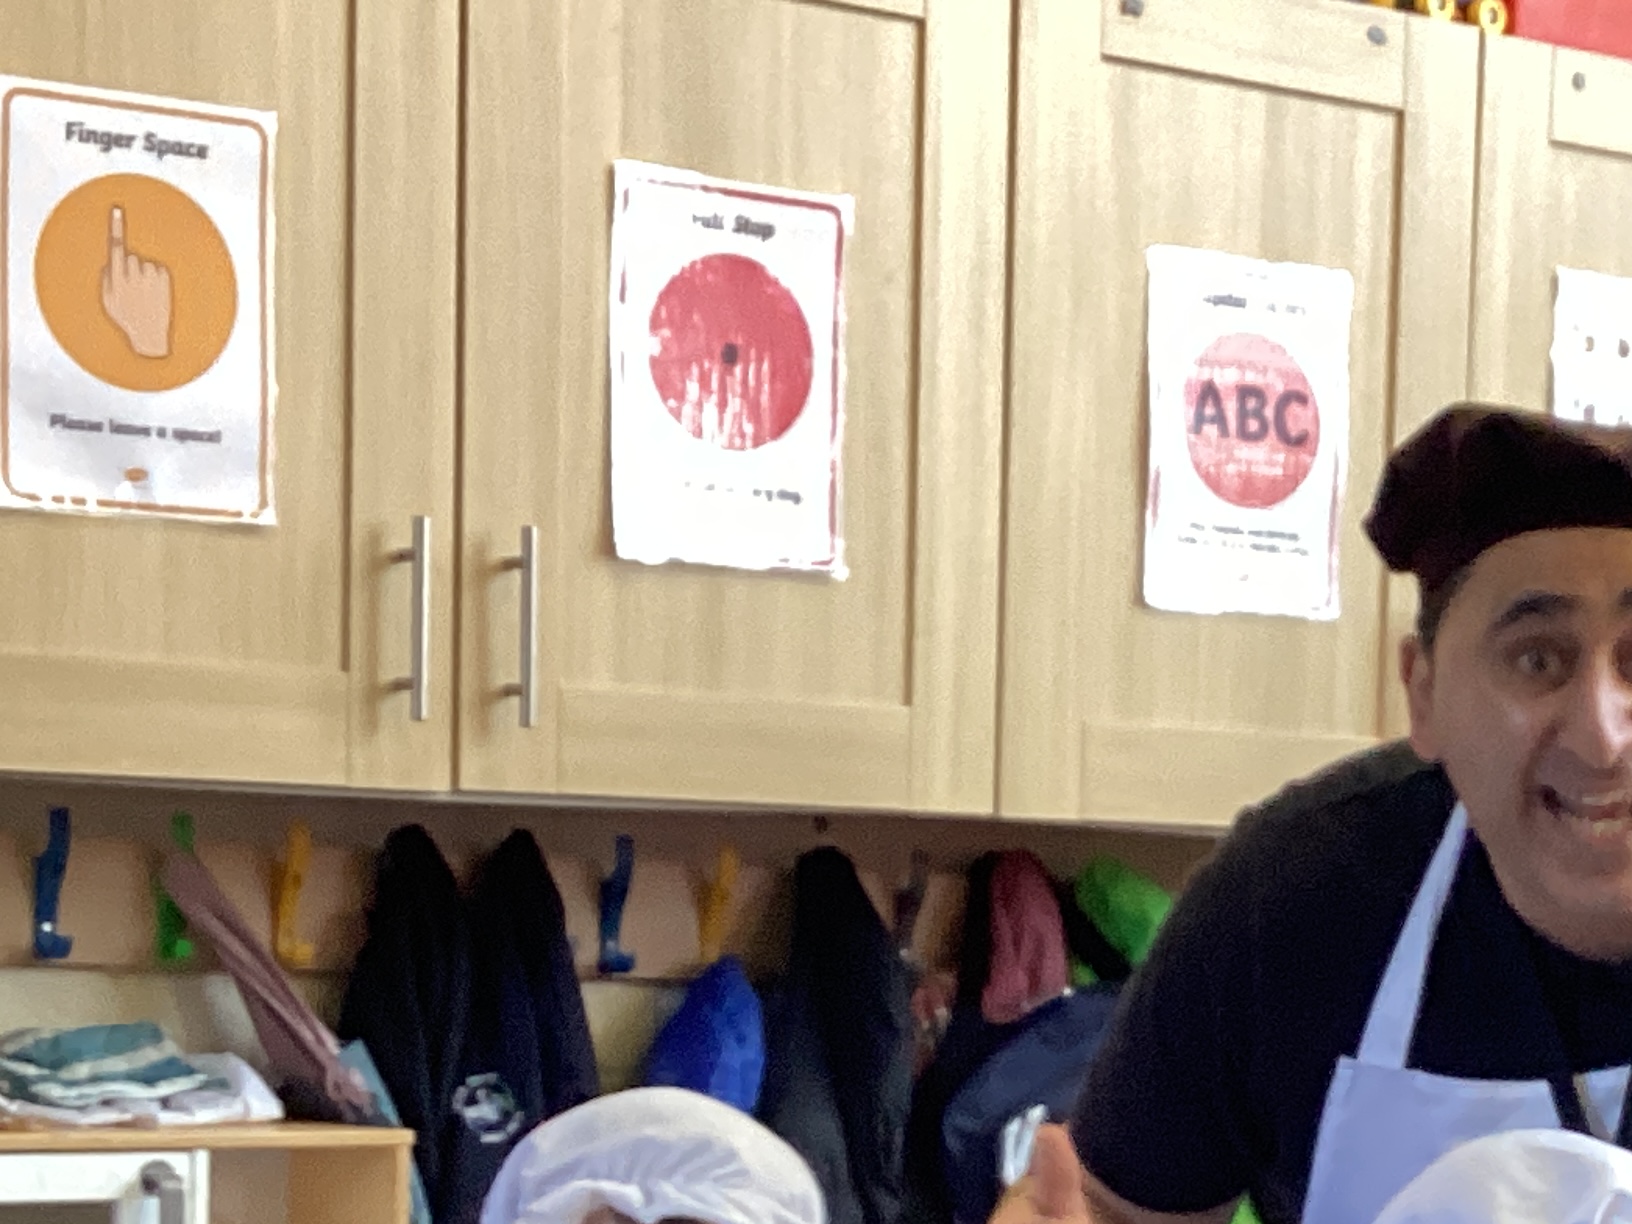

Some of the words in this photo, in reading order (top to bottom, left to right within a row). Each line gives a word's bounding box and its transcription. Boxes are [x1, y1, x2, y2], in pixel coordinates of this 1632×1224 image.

[65, 121, 137, 153] Finger
[142, 131, 209, 160] Space
[1193, 378, 1309, 448] ABC
